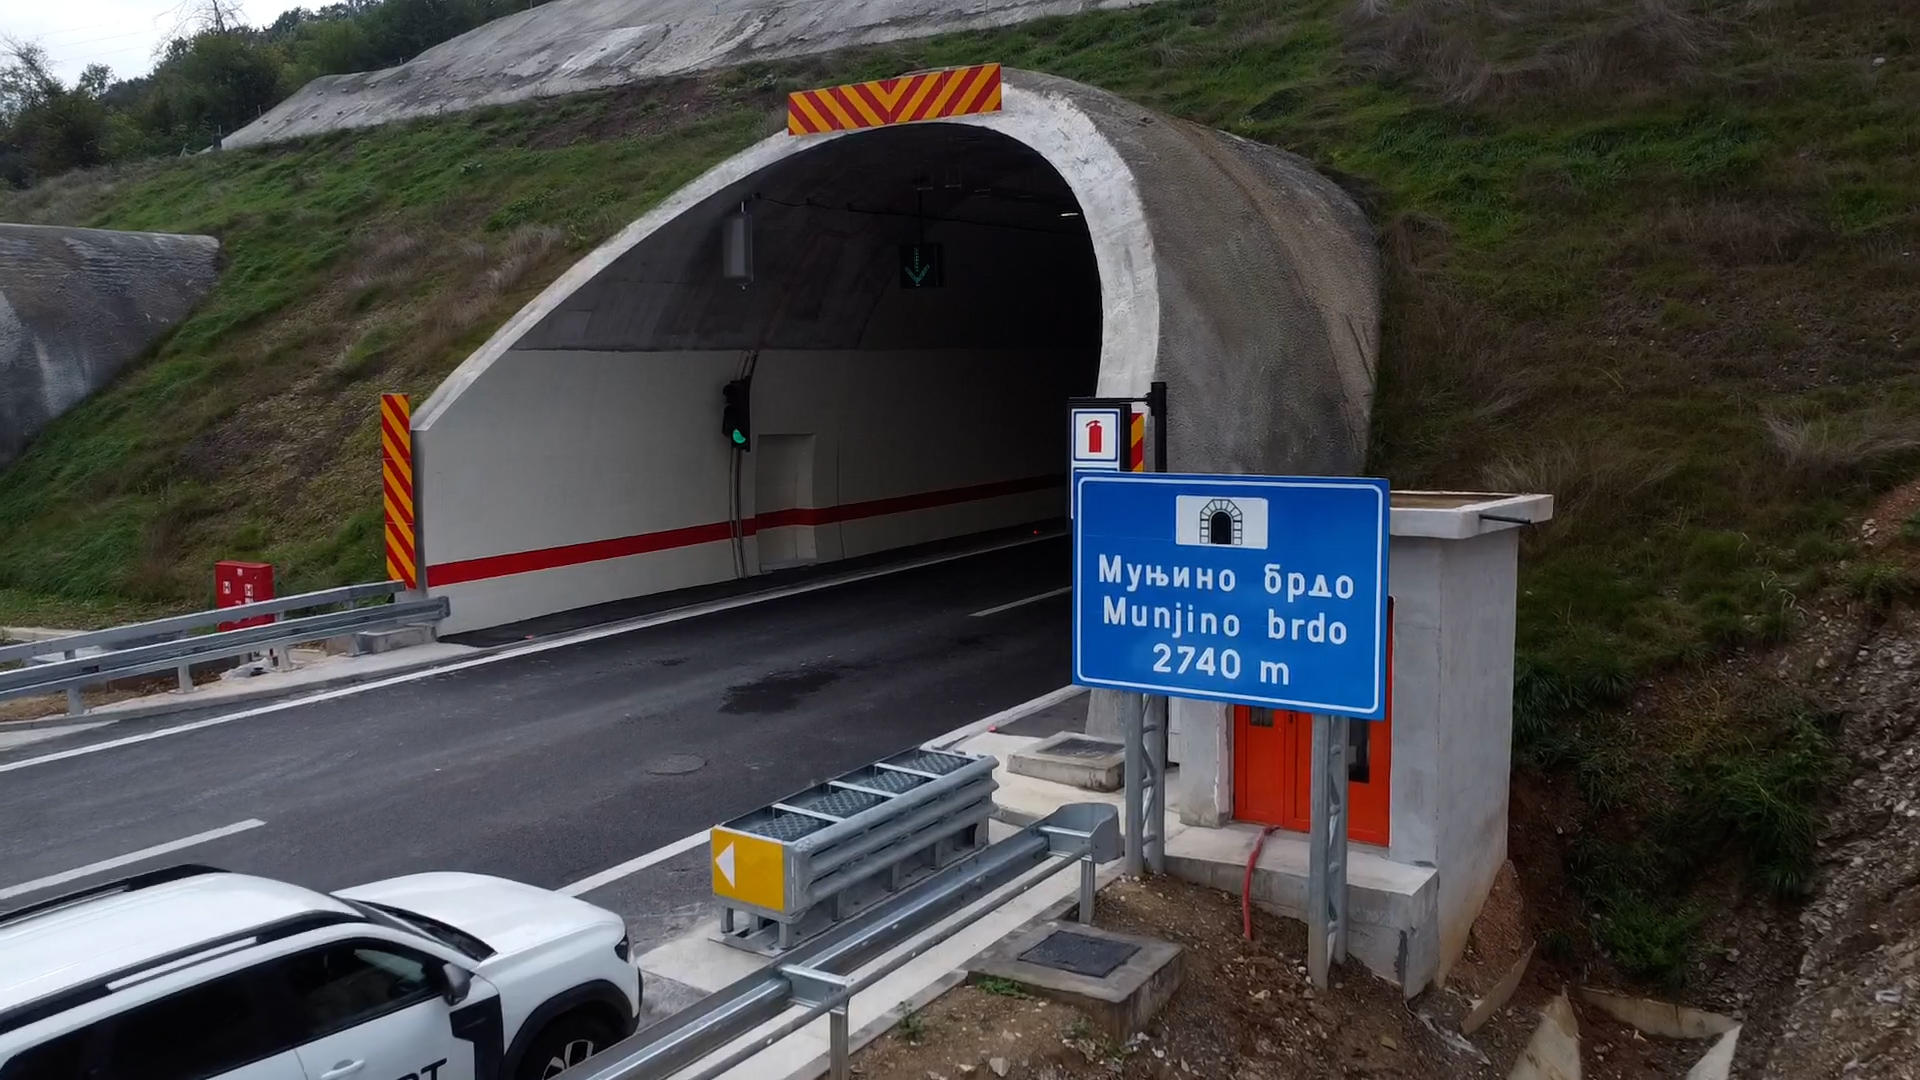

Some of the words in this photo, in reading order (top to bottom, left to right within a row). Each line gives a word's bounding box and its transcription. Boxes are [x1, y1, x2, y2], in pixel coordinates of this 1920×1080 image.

[1099, 553, 1236, 592] Муњино
[1264, 563, 1354, 603] брдо
[1103, 595, 1240, 638] Munjino
[1268, 608, 1347, 645] brdo
[1153, 642, 1241, 680] 2740
[1260, 660, 1289, 685] m
